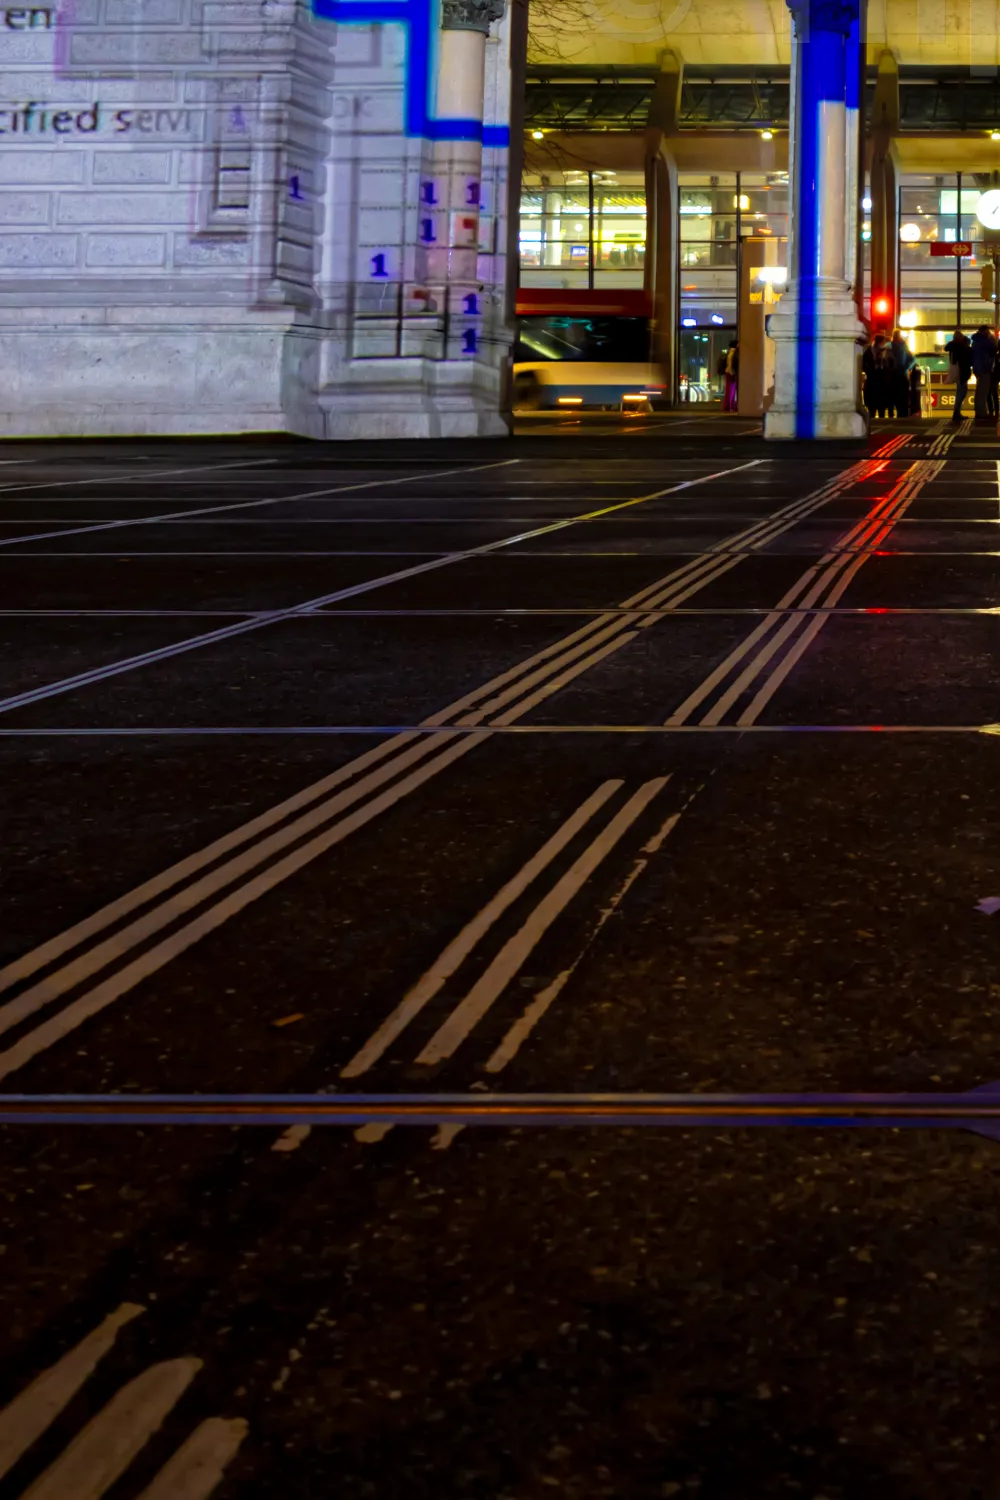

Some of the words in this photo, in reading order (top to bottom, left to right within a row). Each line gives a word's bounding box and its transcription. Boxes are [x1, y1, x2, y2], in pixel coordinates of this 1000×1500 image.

[420, 182, 437, 204] 1
[420, 218, 436, 241] 1
[370, 253, 388, 277] 1
[463, 293, 481, 315] 1
[462, 328, 478, 353] 1
